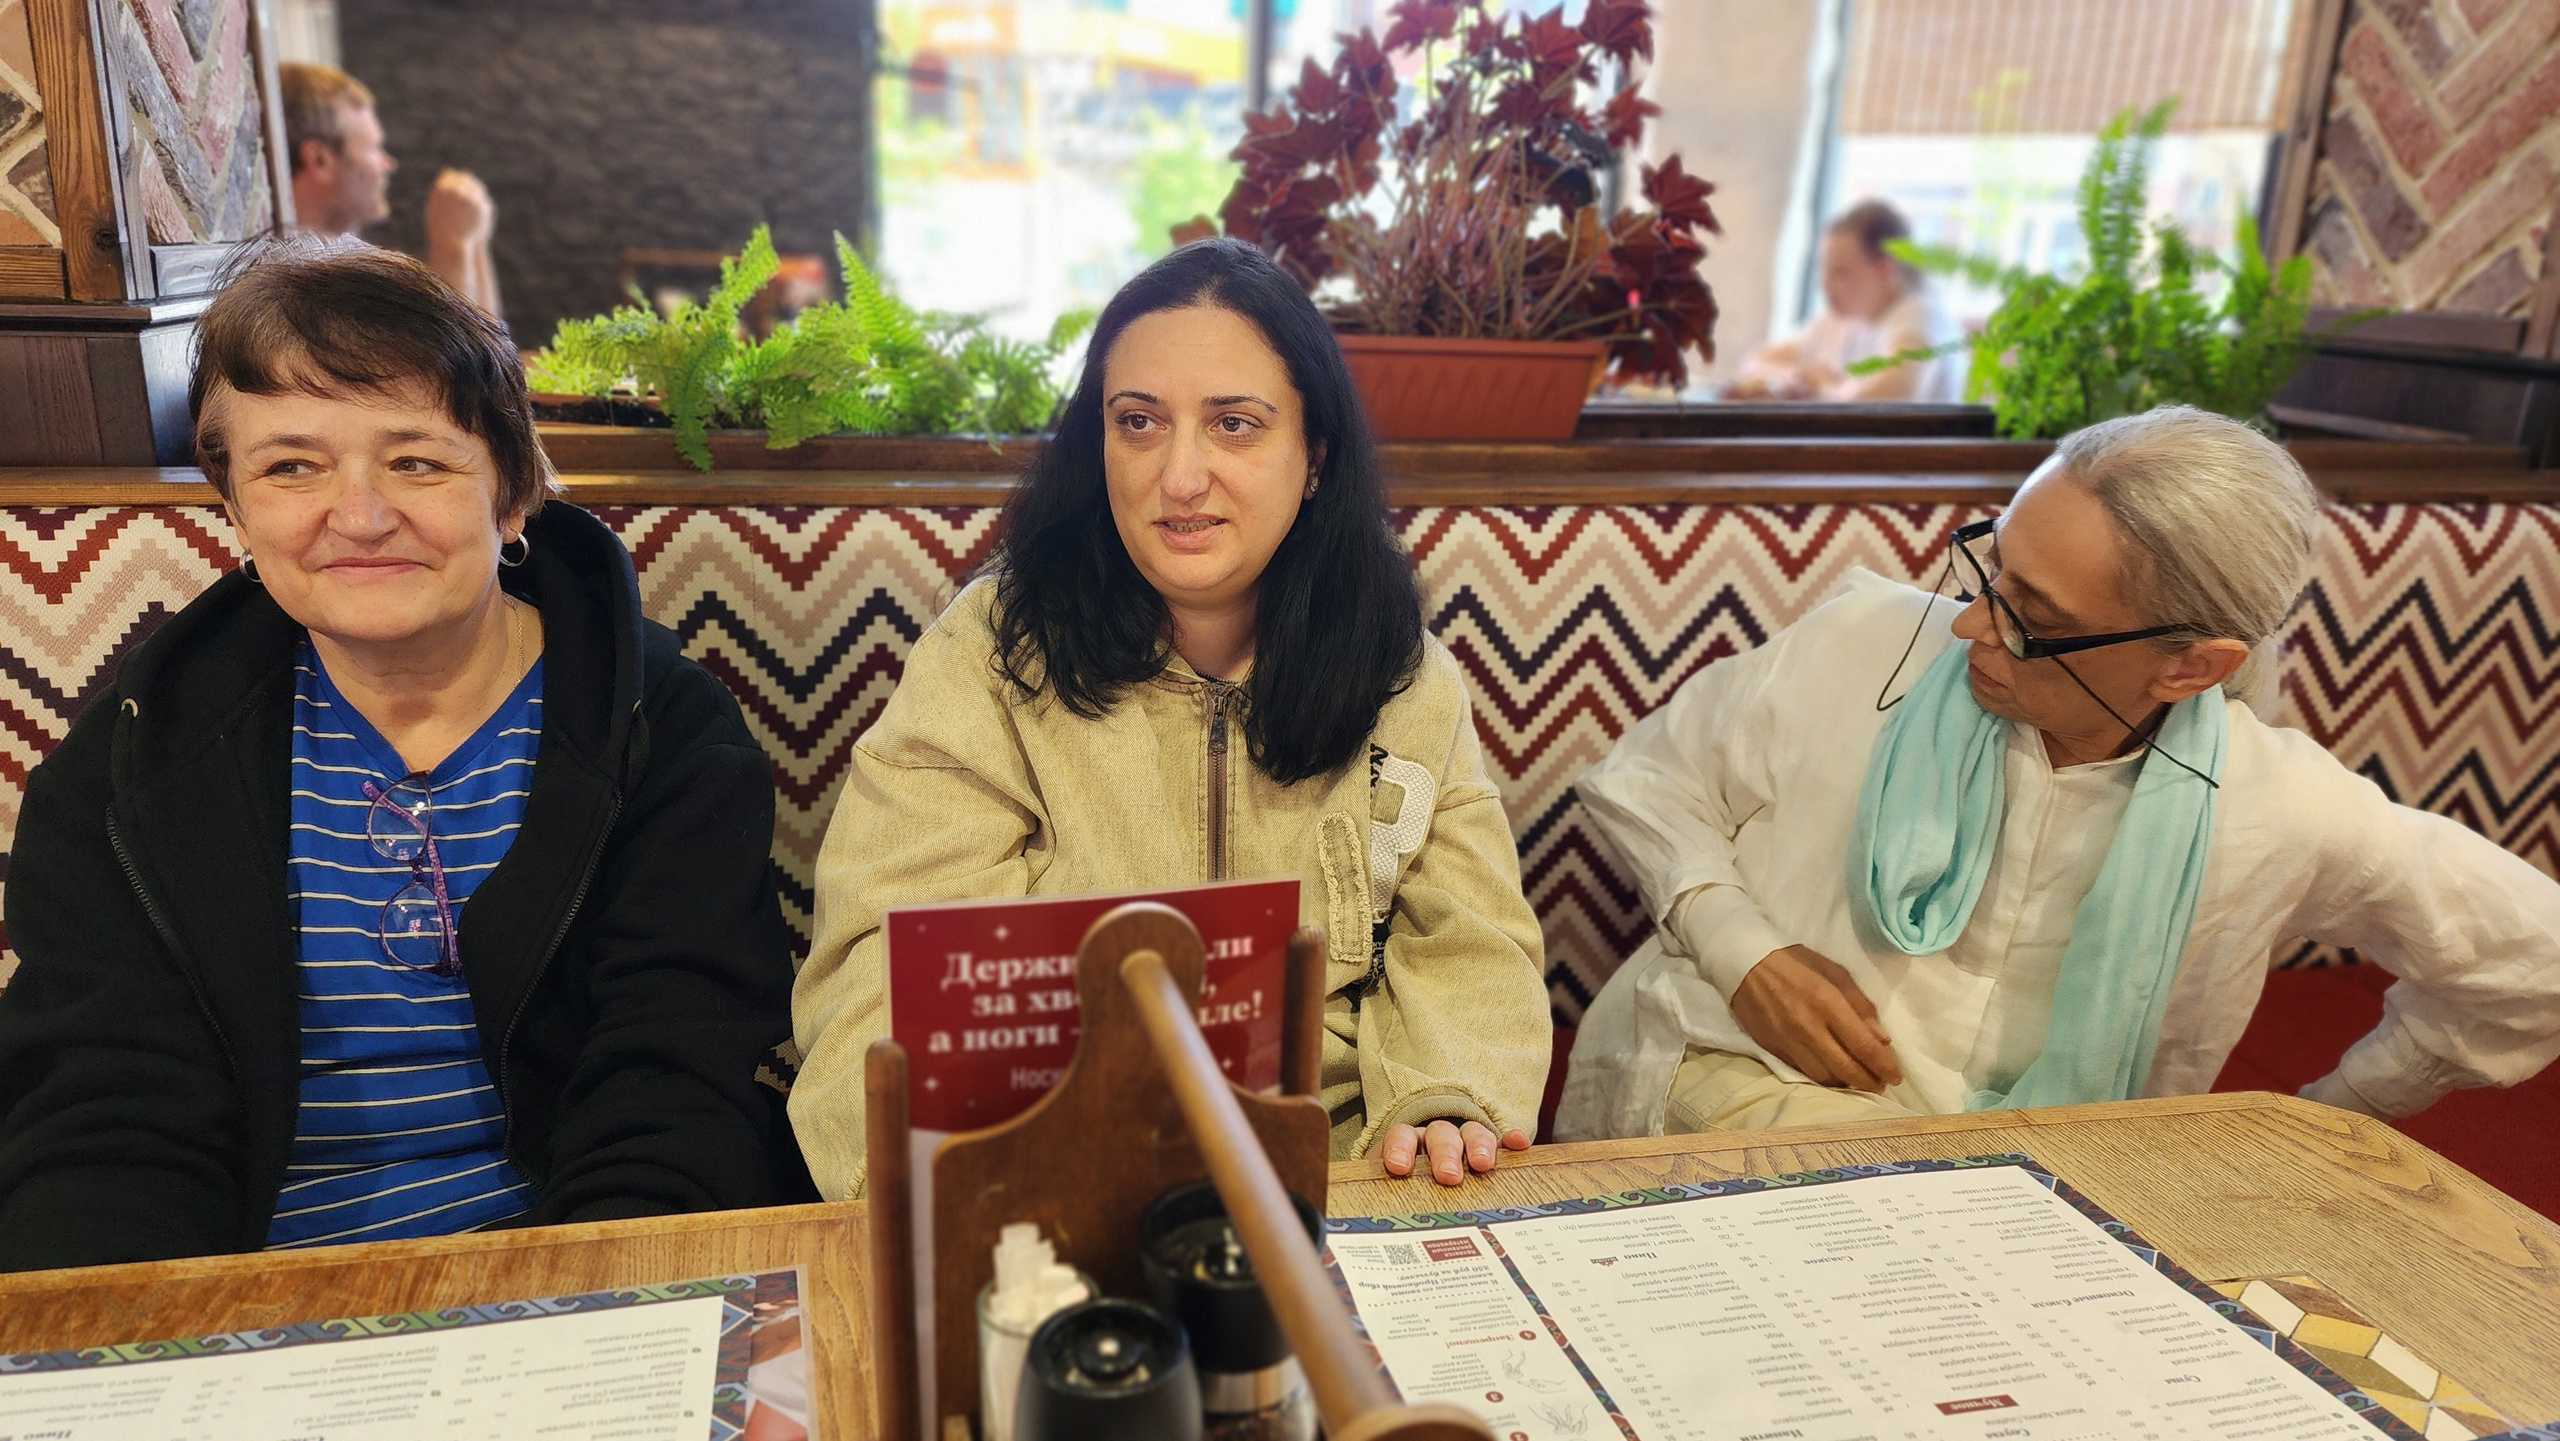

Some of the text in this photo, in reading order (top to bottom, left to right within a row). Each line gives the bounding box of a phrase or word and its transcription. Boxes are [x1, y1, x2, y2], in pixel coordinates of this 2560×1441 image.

[972, 993, 1016, 1017] за
[928, 1023, 1060, 1053] а ноги
[1623, 1251, 1659, 1260] Пиво
[1802, 1254, 1855, 1266] Сладкое
[2030, 1289, 2136, 1309] Основные блюда
[2163, 1373, 2202, 1385] Супы
[1949, 1396, 2005, 1411] Мучное
